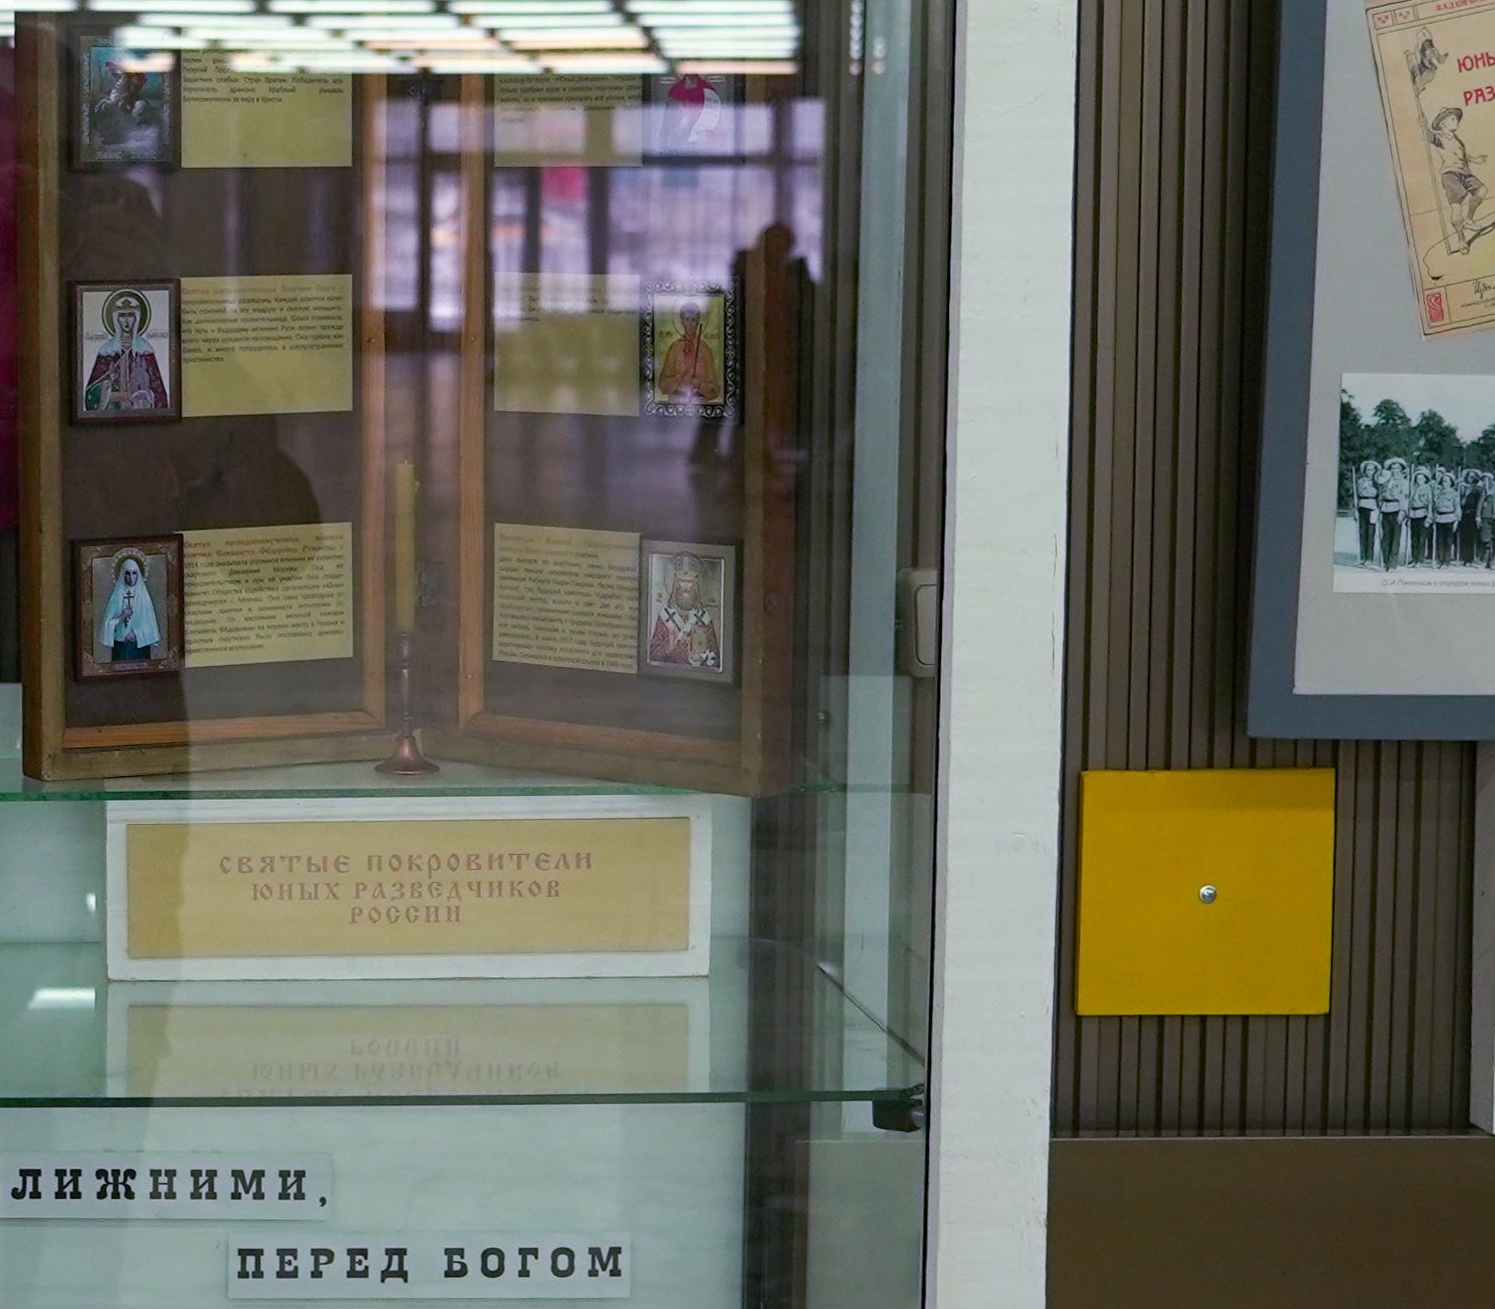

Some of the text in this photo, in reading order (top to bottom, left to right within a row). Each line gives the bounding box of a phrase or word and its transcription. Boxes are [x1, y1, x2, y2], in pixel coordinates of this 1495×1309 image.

[219, 850, 593, 874] СВЯТЫЕ ПОКРОВИТЕЛИ
[251, 878, 561, 902] ЮНЫХ РАЗВЕДЧИКОВ
[348, 905, 462, 925] РОССИИ
[237, 1247, 622, 1283] ПЕРЕД БОГОМ
